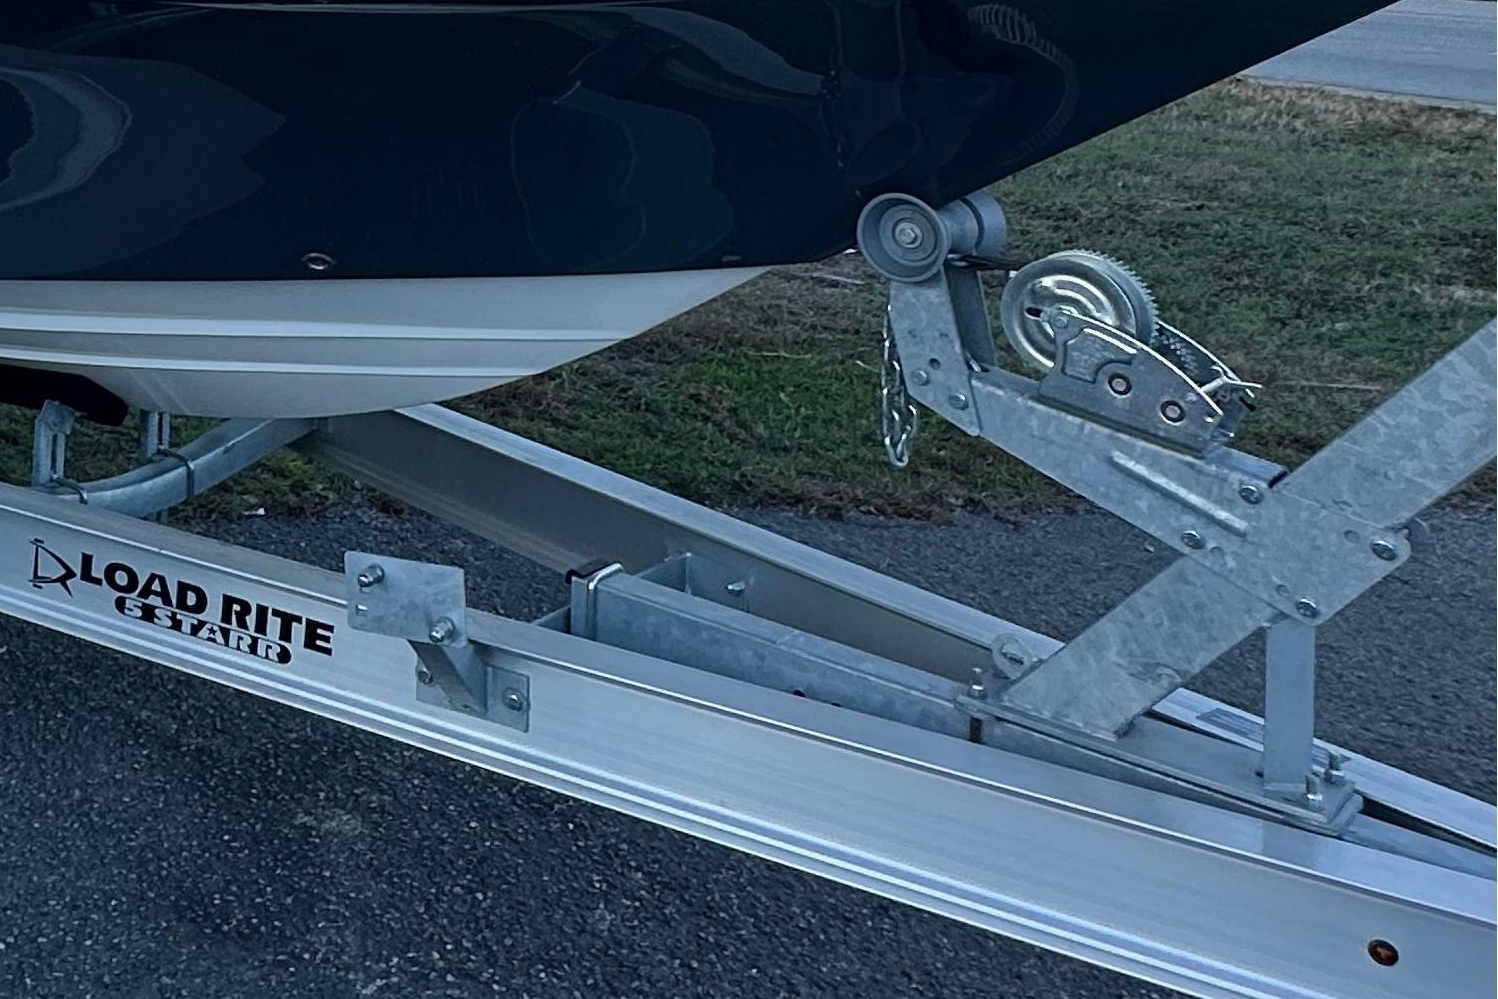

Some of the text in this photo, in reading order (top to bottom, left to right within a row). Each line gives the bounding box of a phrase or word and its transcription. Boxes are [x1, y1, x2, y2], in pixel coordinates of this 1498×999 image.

[80, 552, 335, 657] LOAD RITE
[122, 597, 280, 662] 5 STARR
